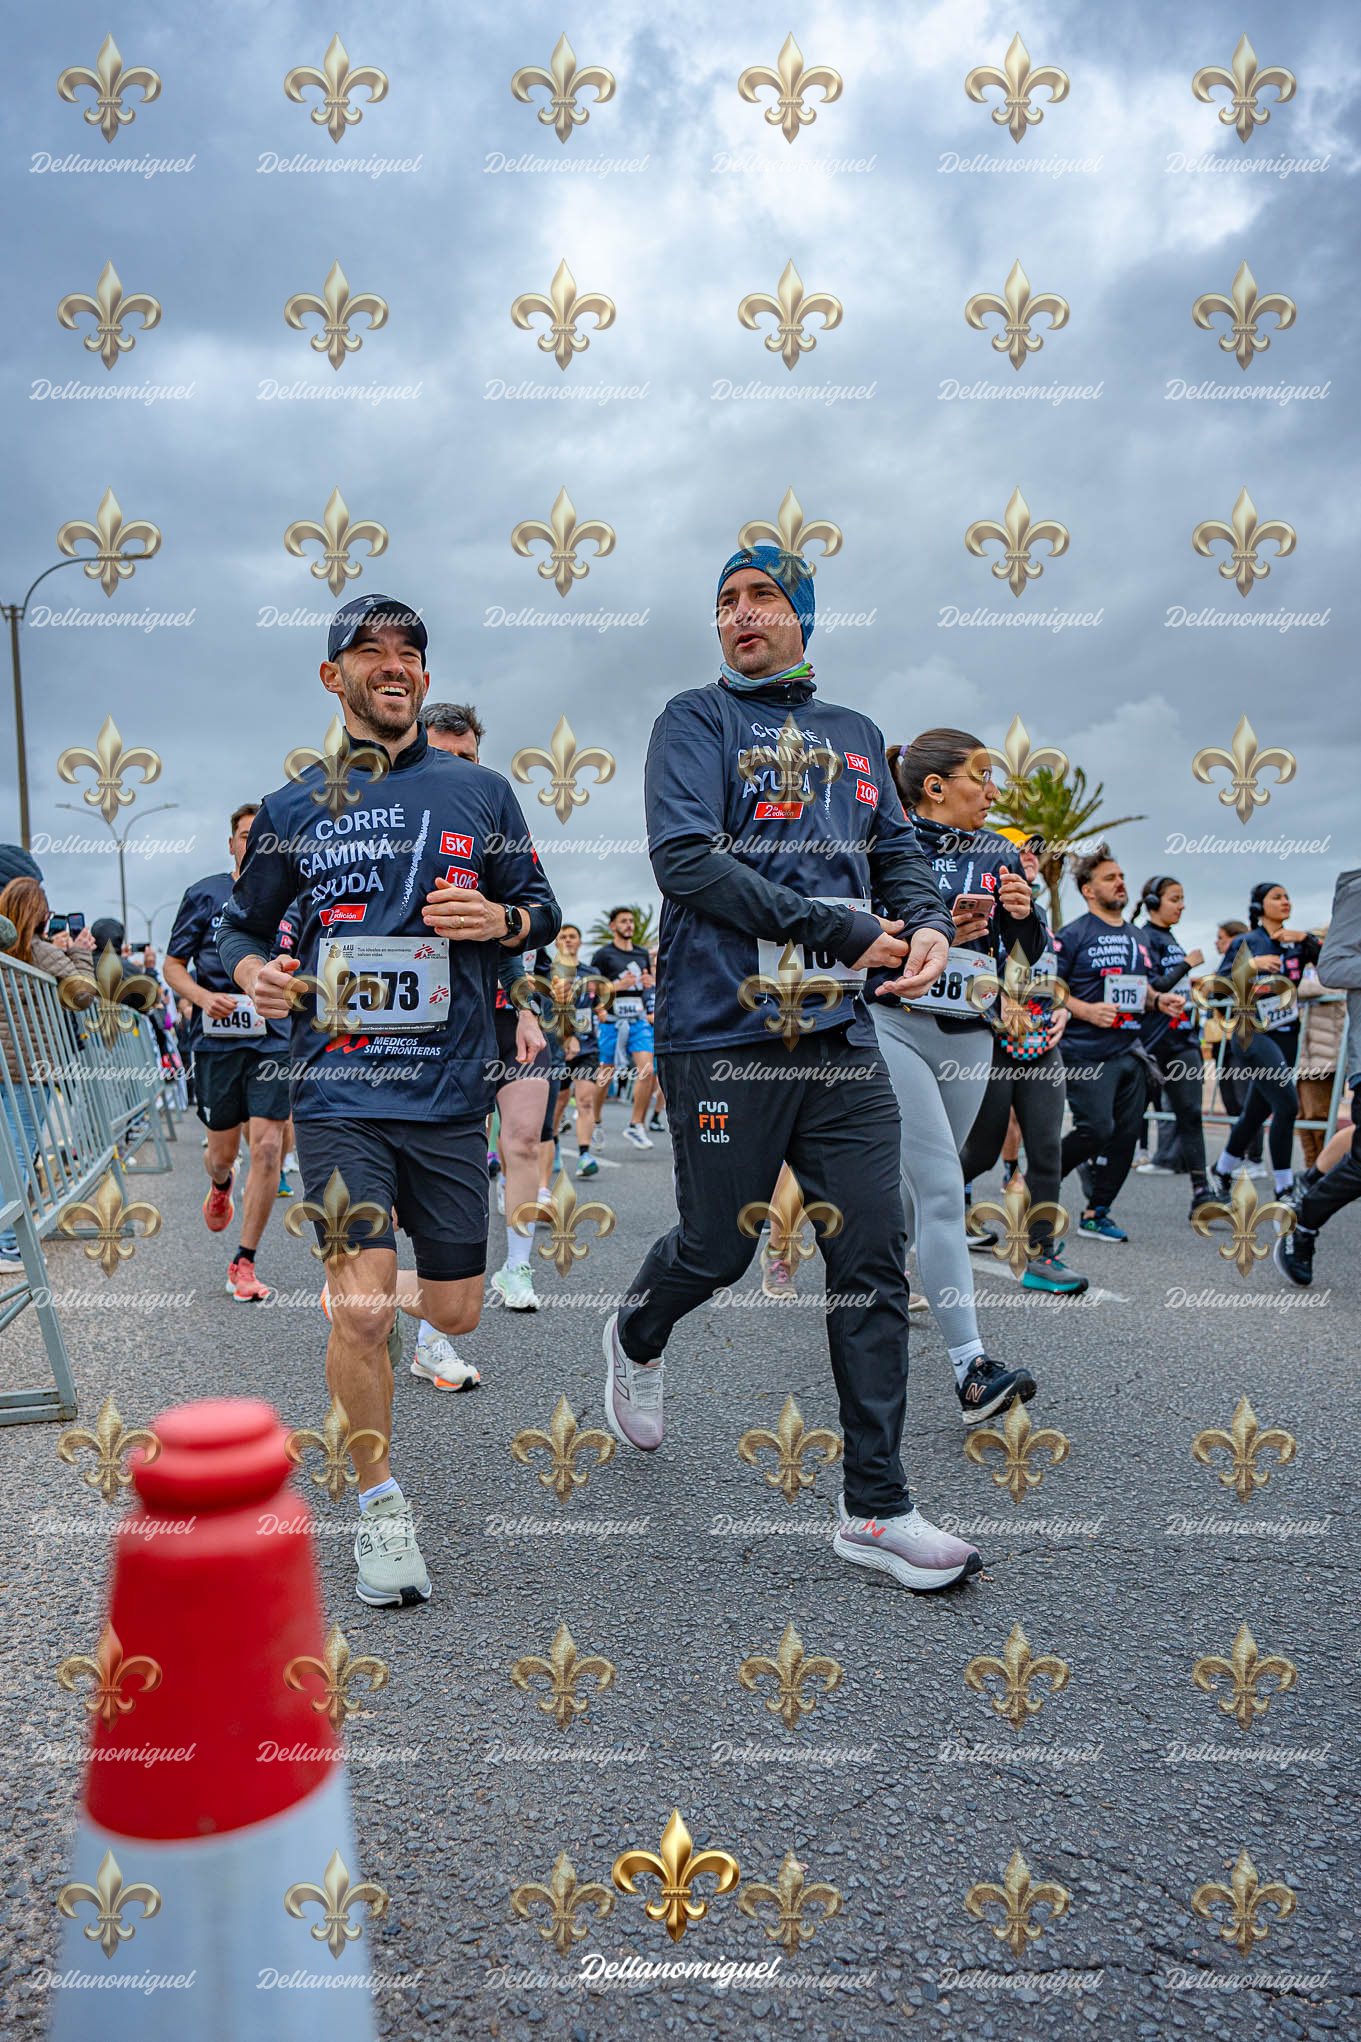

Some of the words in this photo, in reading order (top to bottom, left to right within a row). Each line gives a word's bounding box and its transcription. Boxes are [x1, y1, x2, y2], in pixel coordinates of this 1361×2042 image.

[750, 722, 821, 744] CORRÉ
[737, 744, 819, 768] CAMINÁ
[849, 756, 866, 771] 5K
[742, 770, 811, 799] AYUDÁ
[772, 807, 794, 818] edición
[315, 803, 406, 840] CORRÉ
[445, 836, 468, 853] 5K
[300, 833, 396, 879] CAMINÁ
[311, 865, 384, 905] AYUDÁ
[452, 871, 476, 889] 10K
[336, 970, 419, 1011] 2573
[924, 971, 975, 1001] 981
[1112, 988, 1137, 1005] 3175
[373, 1036, 419, 1046] MEDICOS
[363, 1044, 382, 1054] SIN
[384, 1045, 441, 1056] FRONTERAS
[698, 1100, 729, 1113] run
[699, 1114, 729, 1130] FIT
[700, 1129, 730, 1143] club
